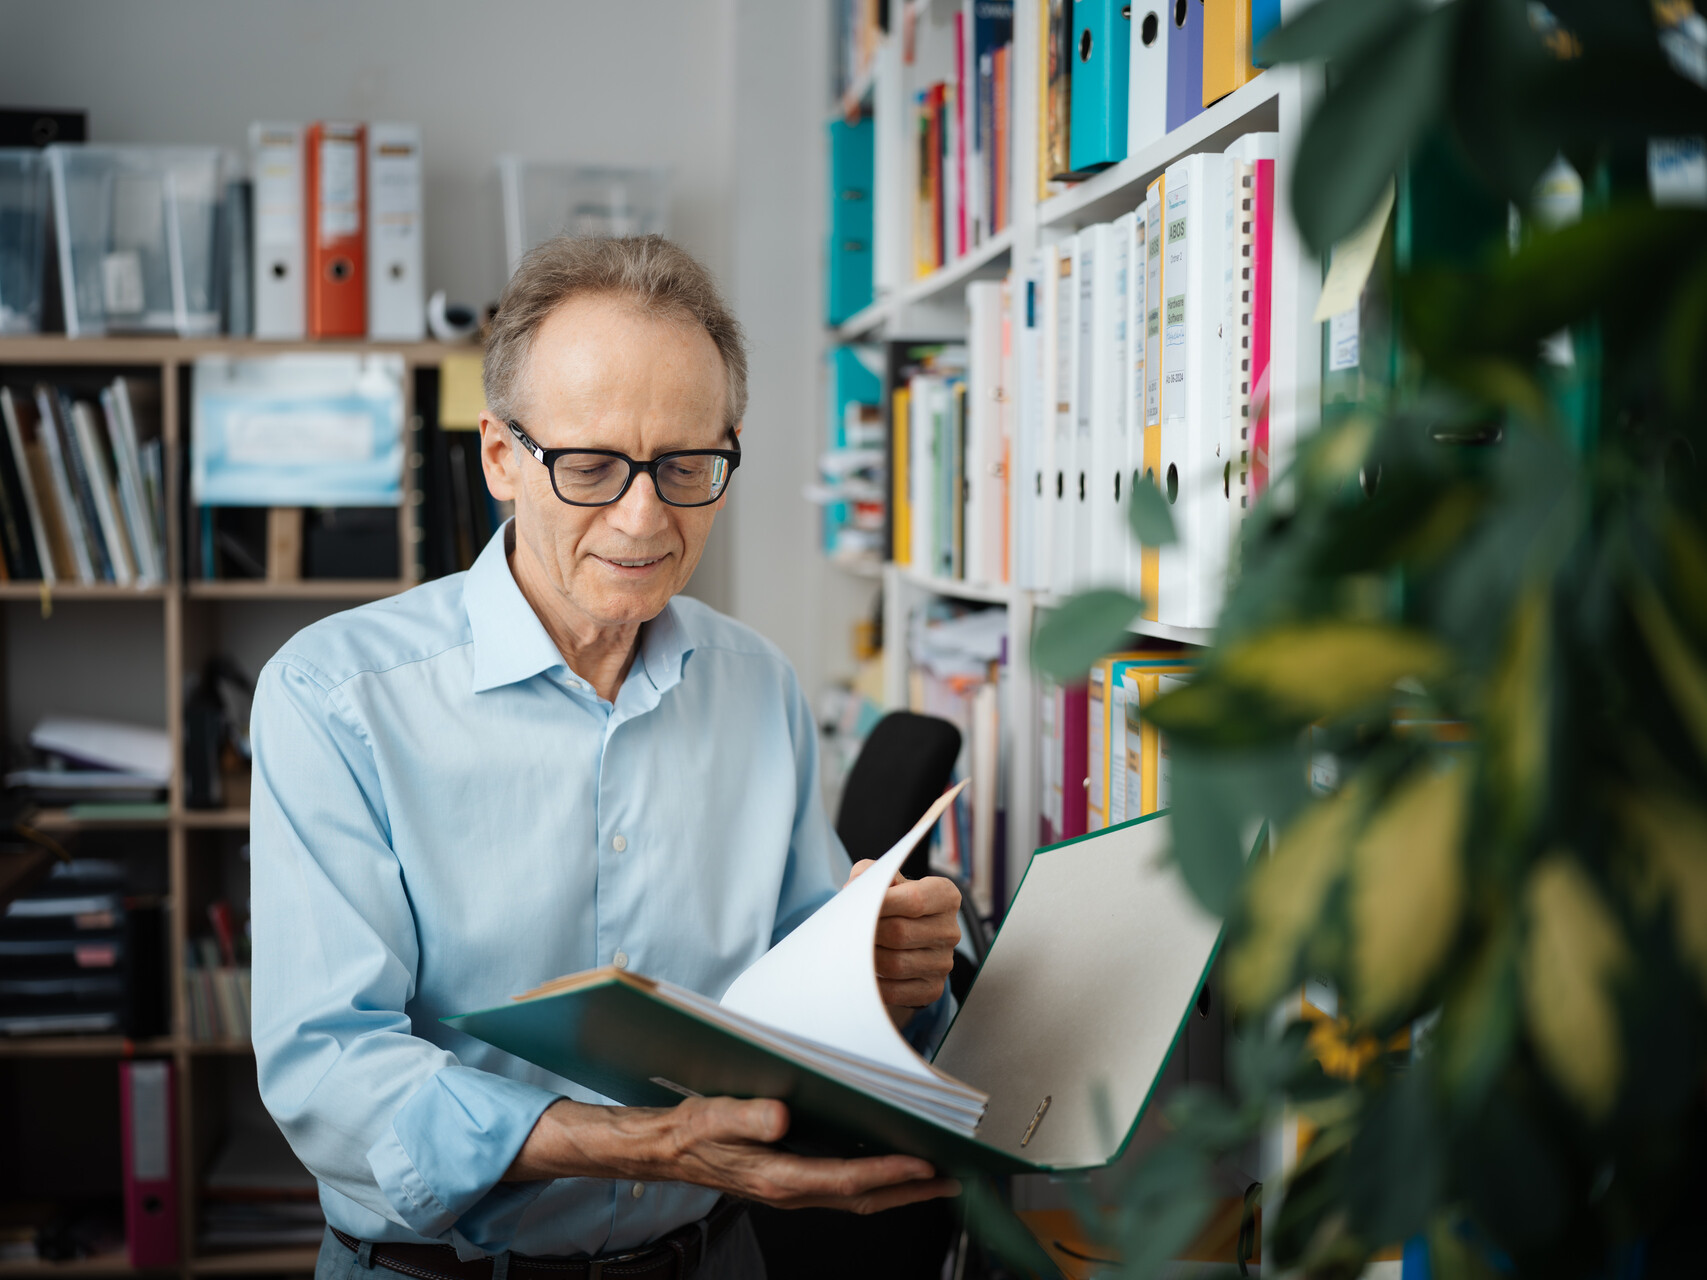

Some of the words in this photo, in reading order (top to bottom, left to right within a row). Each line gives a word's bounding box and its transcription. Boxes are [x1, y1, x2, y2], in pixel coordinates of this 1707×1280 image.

[1169, 221, 1185, 240] ABOS
[1168, 298, 1184, 310] Hardware
[1168, 313, 1183, 324] Software
